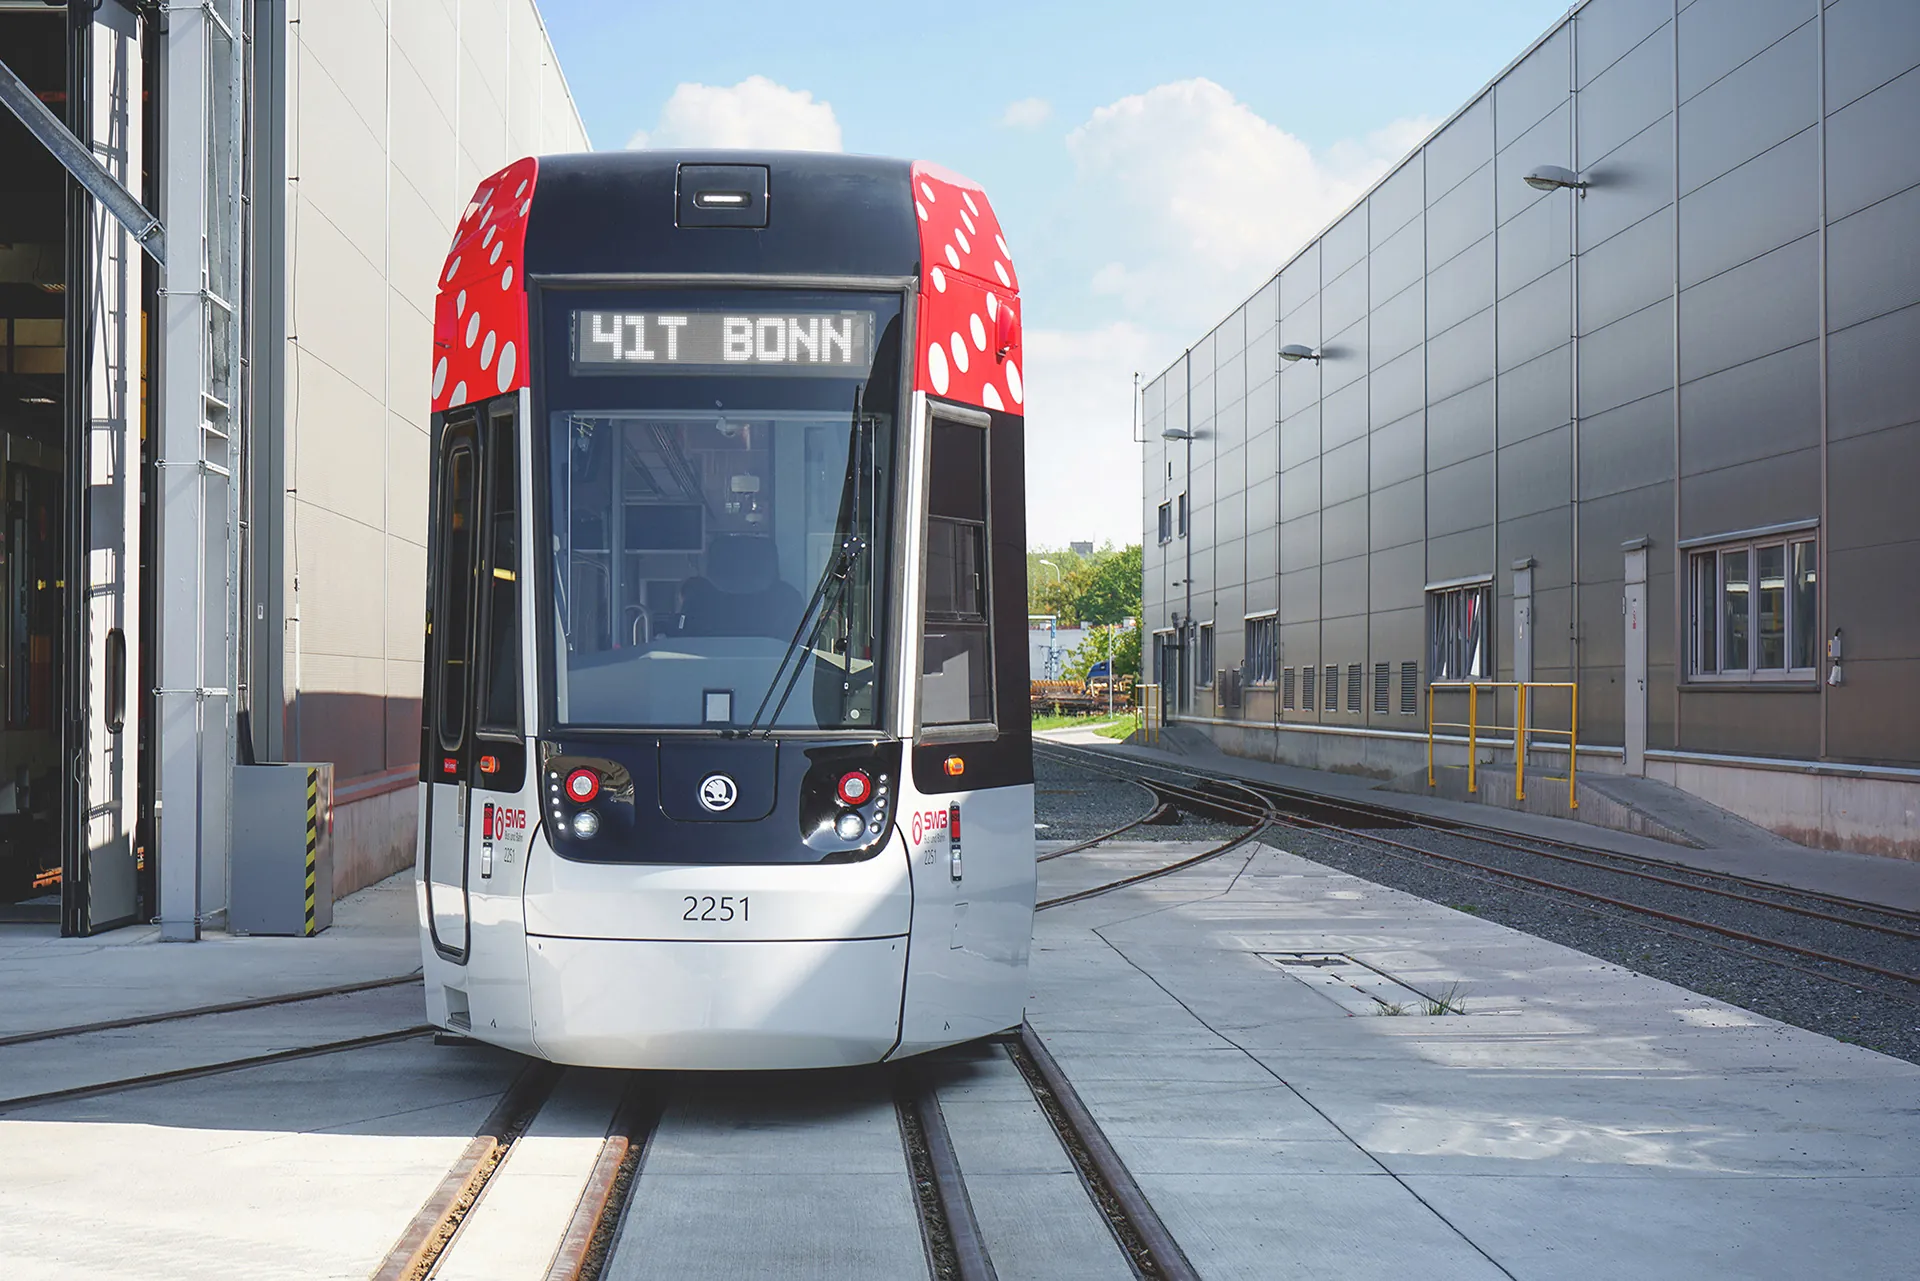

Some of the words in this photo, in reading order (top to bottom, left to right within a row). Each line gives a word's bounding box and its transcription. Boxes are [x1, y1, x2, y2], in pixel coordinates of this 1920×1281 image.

[593, 315, 688, 360] 41T
[725, 316, 852, 362] BONN
[505, 808, 526, 829] SWB
[924, 809, 948, 831] SWB
[504, 847, 515, 863] 2251
[924, 849, 937, 865] 2251
[683, 895, 749, 921] 2251
